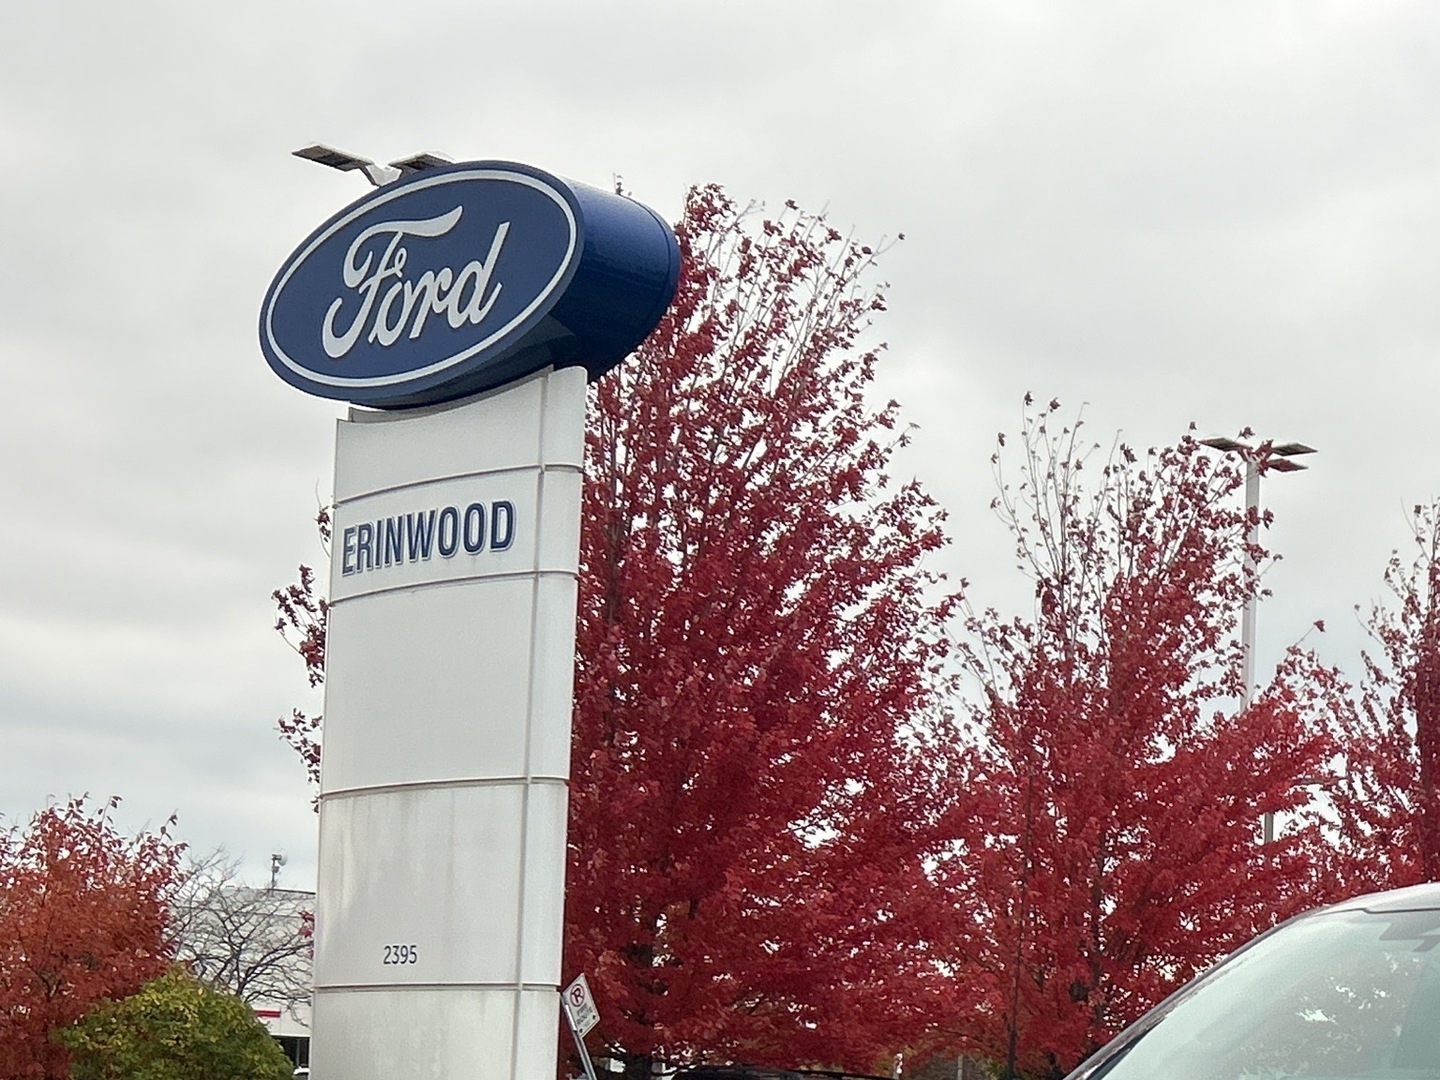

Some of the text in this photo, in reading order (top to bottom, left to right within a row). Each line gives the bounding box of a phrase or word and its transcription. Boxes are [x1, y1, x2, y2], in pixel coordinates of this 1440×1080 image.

[322, 205, 510, 358] Ford
[341, 499, 516, 577] ERINWOOD
[383, 945, 418, 965] 2395
